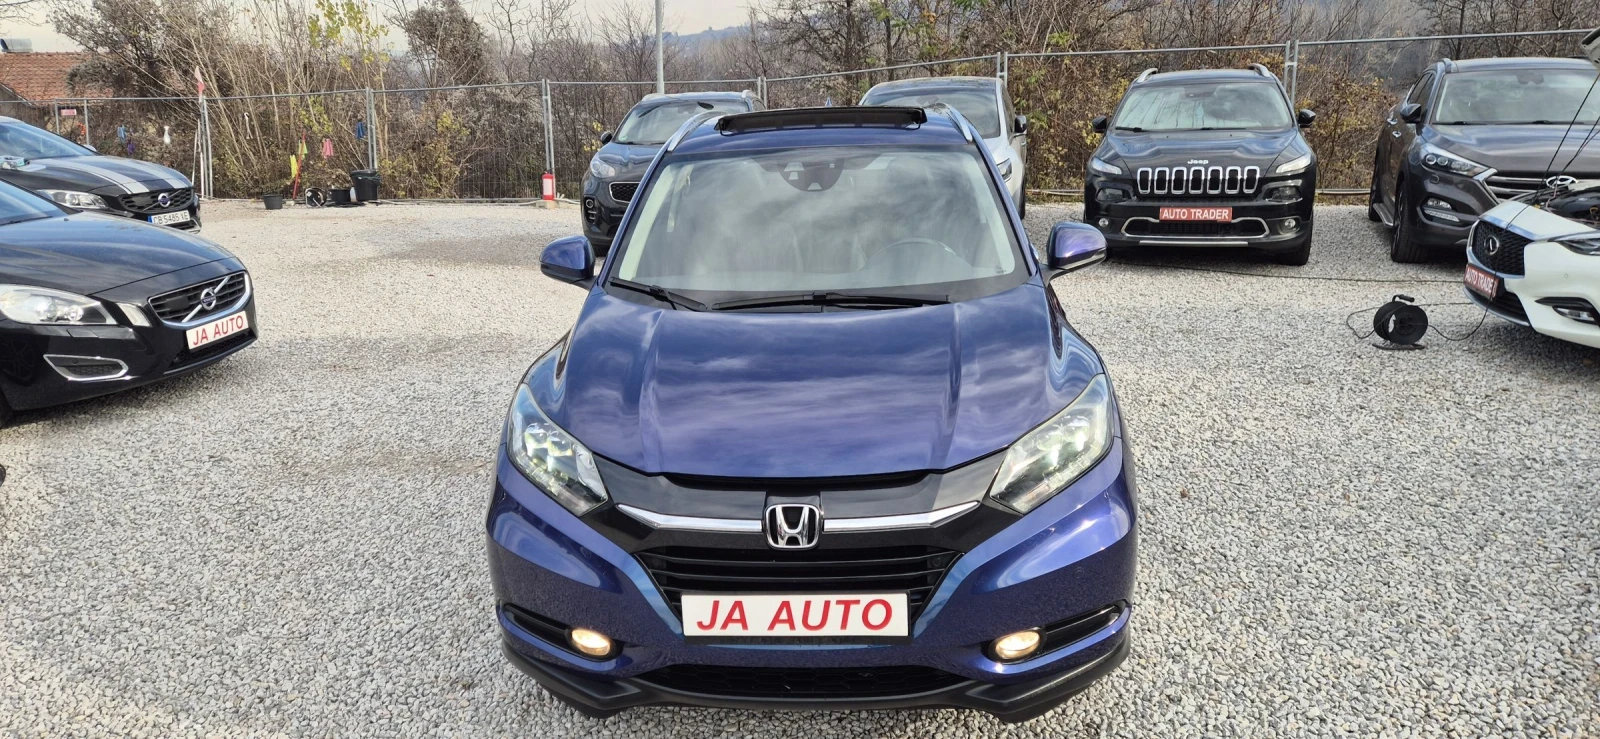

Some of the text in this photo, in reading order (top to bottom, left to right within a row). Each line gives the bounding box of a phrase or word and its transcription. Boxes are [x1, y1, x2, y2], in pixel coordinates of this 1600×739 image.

[1162, 209, 1229, 219] AUTO TRADER
[1464, 267, 1478, 284] AUTO
[193, 315, 244, 346] JA AUTO
[696, 598, 893, 631] JA AUTO
